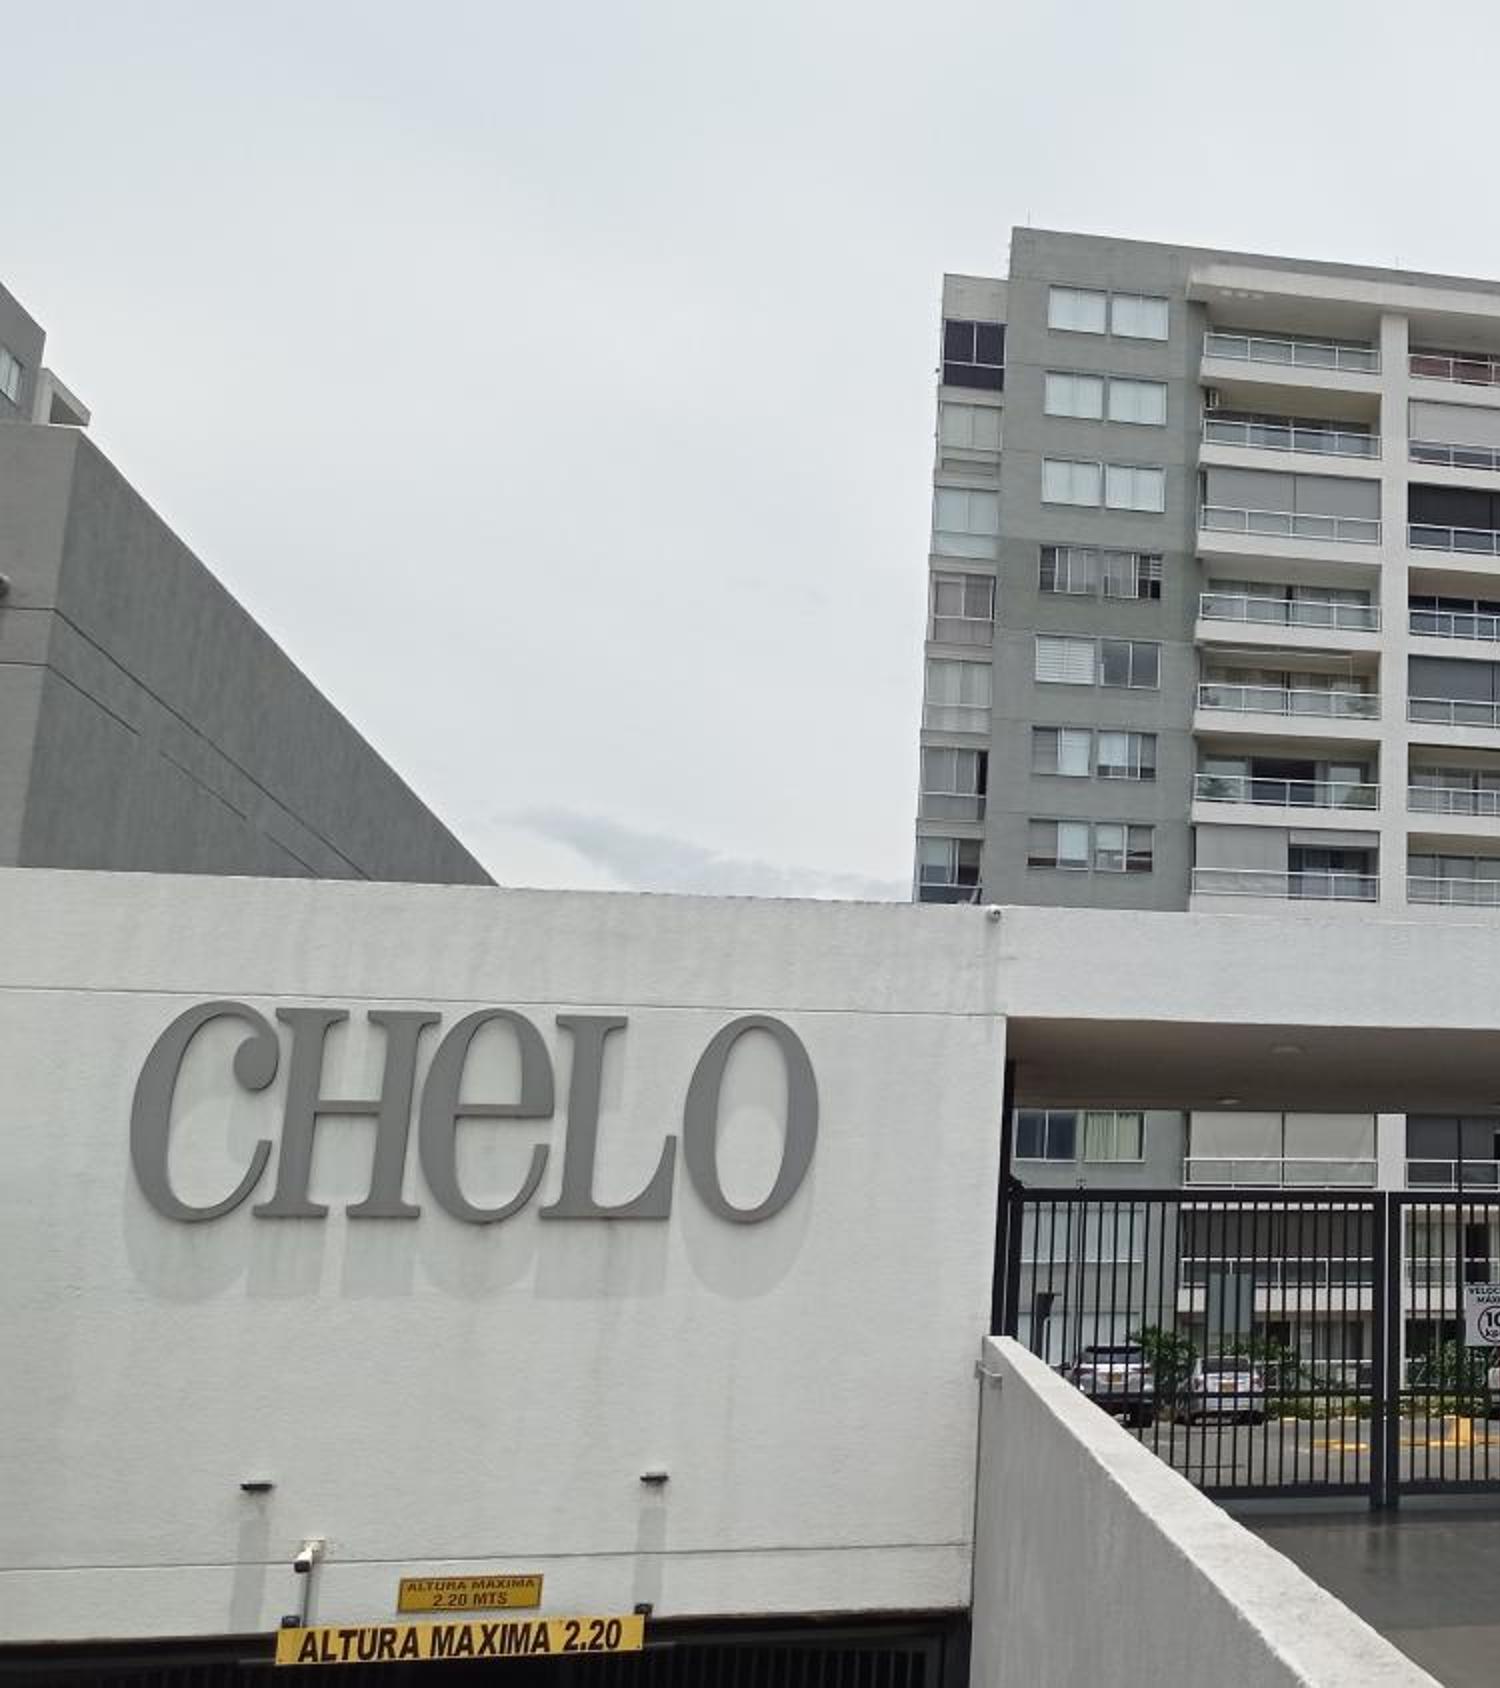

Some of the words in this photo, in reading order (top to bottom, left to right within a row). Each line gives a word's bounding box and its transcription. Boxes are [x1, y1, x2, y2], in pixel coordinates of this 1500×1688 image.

[406, 1581, 467, 1593] ALTURA
[471, 1578, 536, 1590] MAXIMA
[432, 1593, 467, 1607] 2.20
[472, 1591, 509, 1606] MTS
[298, 1626, 420, 1664] ALTURA
[429, 1622, 551, 1658] MAXIMA
[562, 1618, 623, 1652] 2.20
